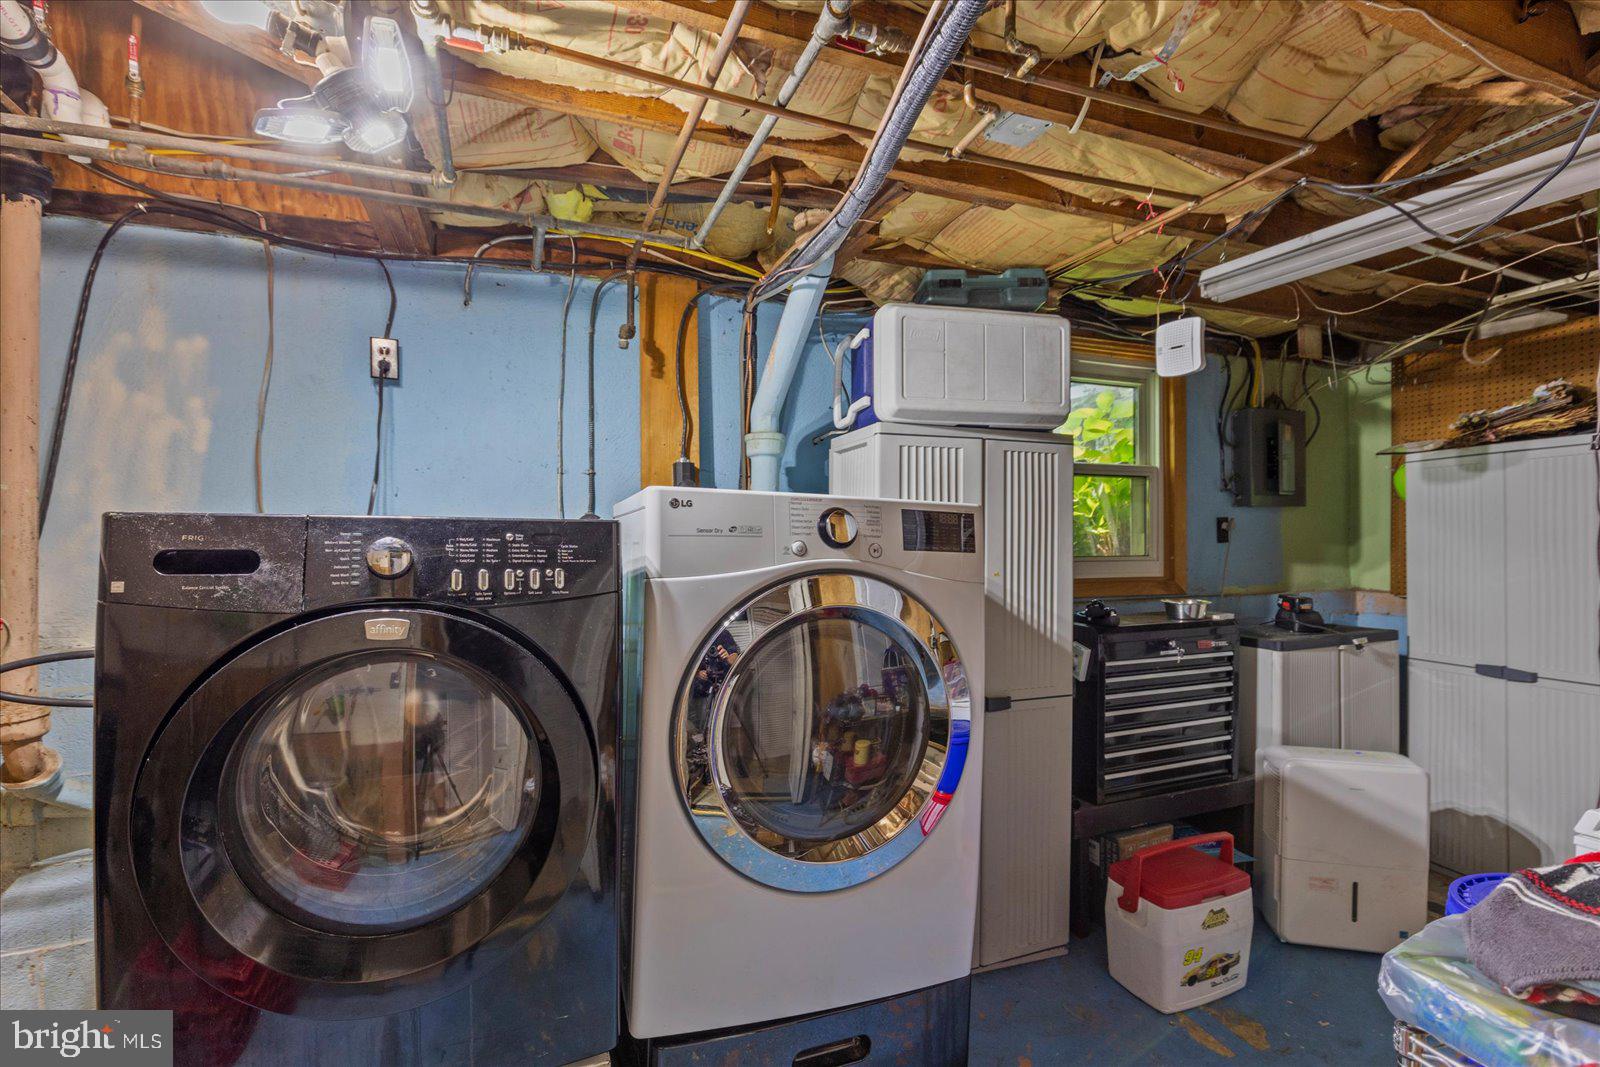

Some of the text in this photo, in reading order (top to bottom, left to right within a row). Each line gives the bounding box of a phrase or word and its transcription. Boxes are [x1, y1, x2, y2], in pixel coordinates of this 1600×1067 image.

[681, 500, 693, 508] LG
[369, 624, 406, 635] affinity
[1183, 946, 1204, 966] 94
